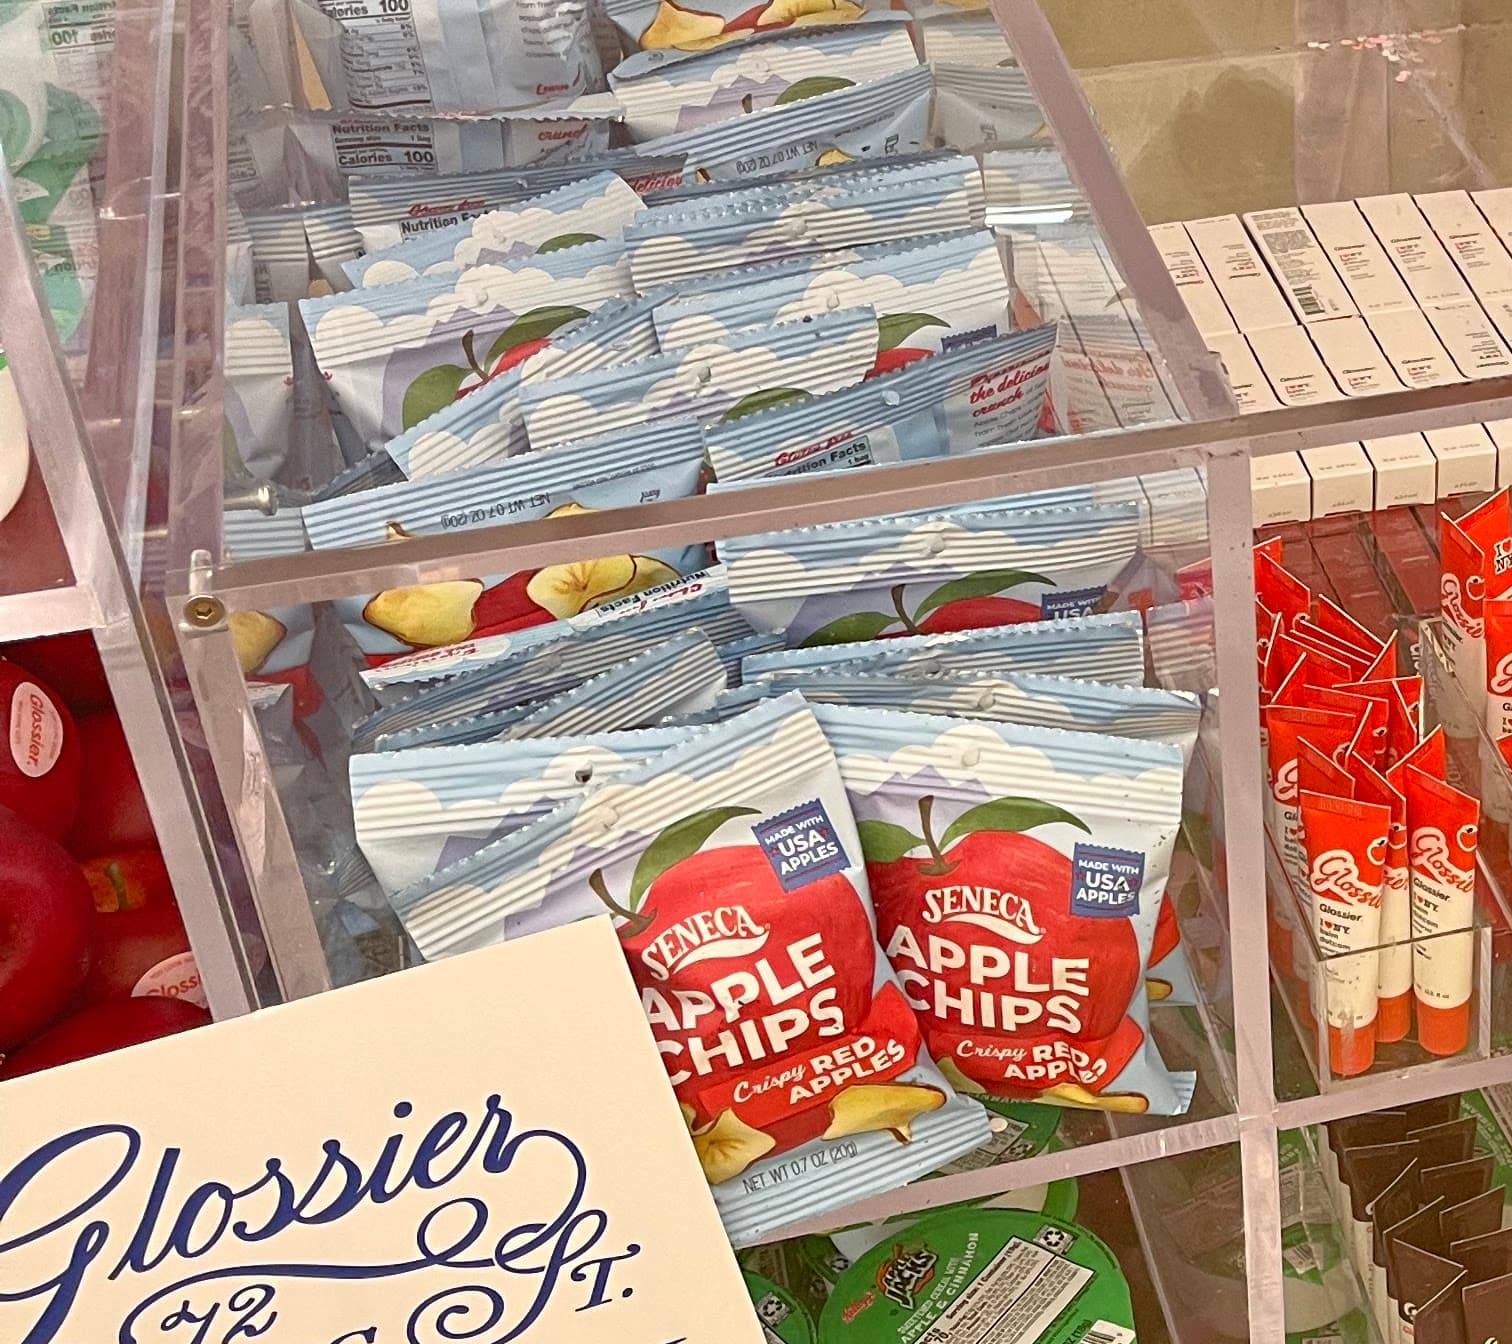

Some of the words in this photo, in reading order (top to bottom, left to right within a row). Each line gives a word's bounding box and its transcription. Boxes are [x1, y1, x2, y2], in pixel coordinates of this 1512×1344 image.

[332, 122, 391, 136] Nutrition
[394, 122, 431, 134] Facts
[338, 151, 393, 166] Calories
[402, 150, 435, 164] 100
[400, 215, 458, 235] Nutrition
[829, 441, 867, 463] Facts
[507, 499, 529, 515] WT
[529, 492, 551, 508] NET
[764, 825, 798, 846] MADE
[798, 814, 825, 832] WITH
[777, 831, 823, 859] USA
[780, 841, 840, 876] APPLES
[1078, 859, 1109, 872] MADE
[1111, 861, 1140, 875] WITH
[1075, 886, 1135, 906] APPLES
[1085, 870, 1131, 892] USA
[921, 885, 1041, 936] SENECA
[641, 904, 766, 983] SENECA
[885, 924, 1091, 997] APPLE
[640, 932, 837, 1033] APPLE
[897, 968, 1082, 1035] CHIPS
[657, 987, 846, 1088] CHIPS
[956, 1039, 1028, 1062] Crispy
[1031, 1041, 1091, 1069] RED
[733, 1063, 807, 1105] Crispy
[809, 1035, 877, 1074] RED
[788, 1037, 906, 1106] APPLES
[742, 1170, 768, 1195] NET
[768, 1164, 792, 1184] WT
[790, 1157, 811, 1177] 0.7
[811, 1151, 829, 1169] OZ
[829, 1140, 858, 1166] (20g)
